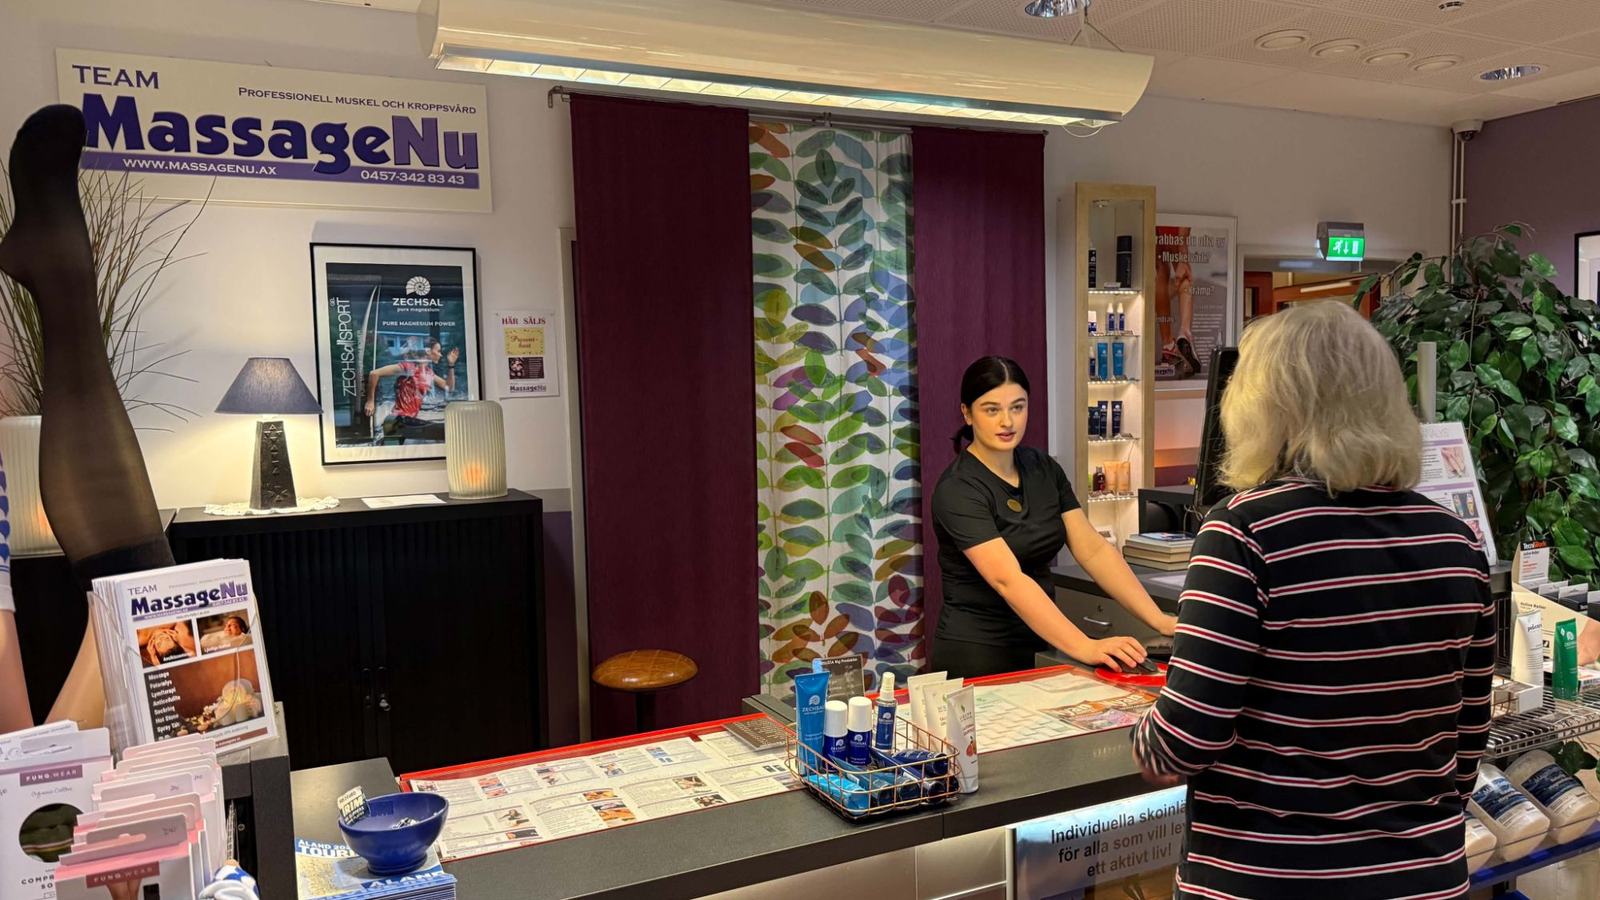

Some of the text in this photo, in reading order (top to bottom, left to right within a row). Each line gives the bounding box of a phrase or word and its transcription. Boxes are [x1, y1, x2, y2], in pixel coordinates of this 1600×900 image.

[72, 64, 159, 89] TEAM
[238, 87, 477, 114] PROFESSIONELL MUSKEL OCH KROPPSVÅRD
[82, 93, 480, 175] MassageNu
[122, 158, 277, 176] WWW.MASSAGENU.AX
[360, 170, 465, 185] 0457-342 83 43
[392, 297, 444, 307] ZECHSAL
[128, 584, 158, 596] TEAM
[131, 581, 248, 616] MassageNu
[157, 724, 171, 733] Spray
[1051, 815, 1135, 844] Individuella
[1058, 846, 1080, 863] för
[1084, 841, 1109, 857] alla
[1113, 833, 1143, 850] som
[1147, 824, 1167, 841] vill
[1087, 843, 1172, 877] ett aktivt liv!
